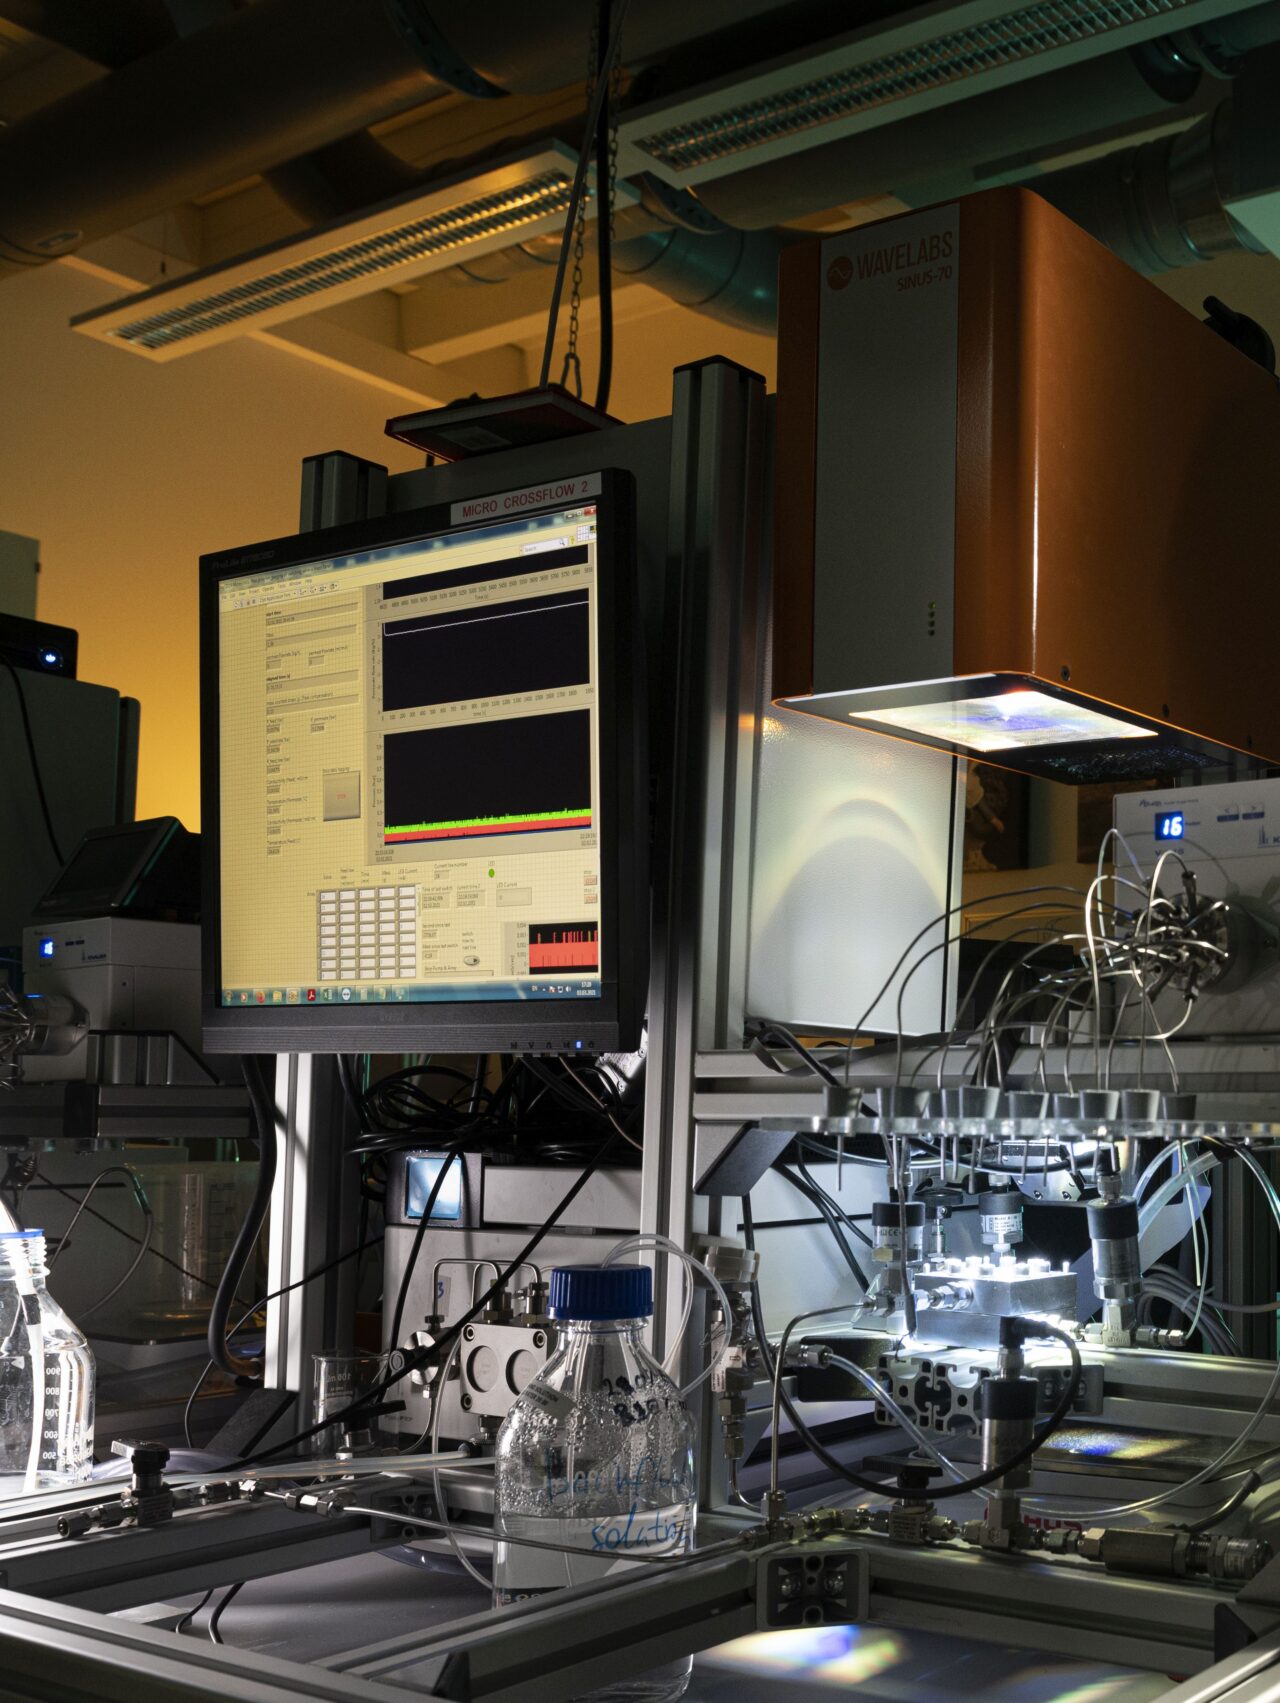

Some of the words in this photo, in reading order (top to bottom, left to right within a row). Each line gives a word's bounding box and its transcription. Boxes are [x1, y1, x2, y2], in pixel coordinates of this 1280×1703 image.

[857, 231, 953, 280] WAVELABS
[897, 266, 952, 291] SINUS-70
[463, 500, 497, 518] MICRO
[504, 484, 575, 509] CROSSFLOW
[582, 481, 588, 492] 2
[1163, 816, 1182, 836] 16
